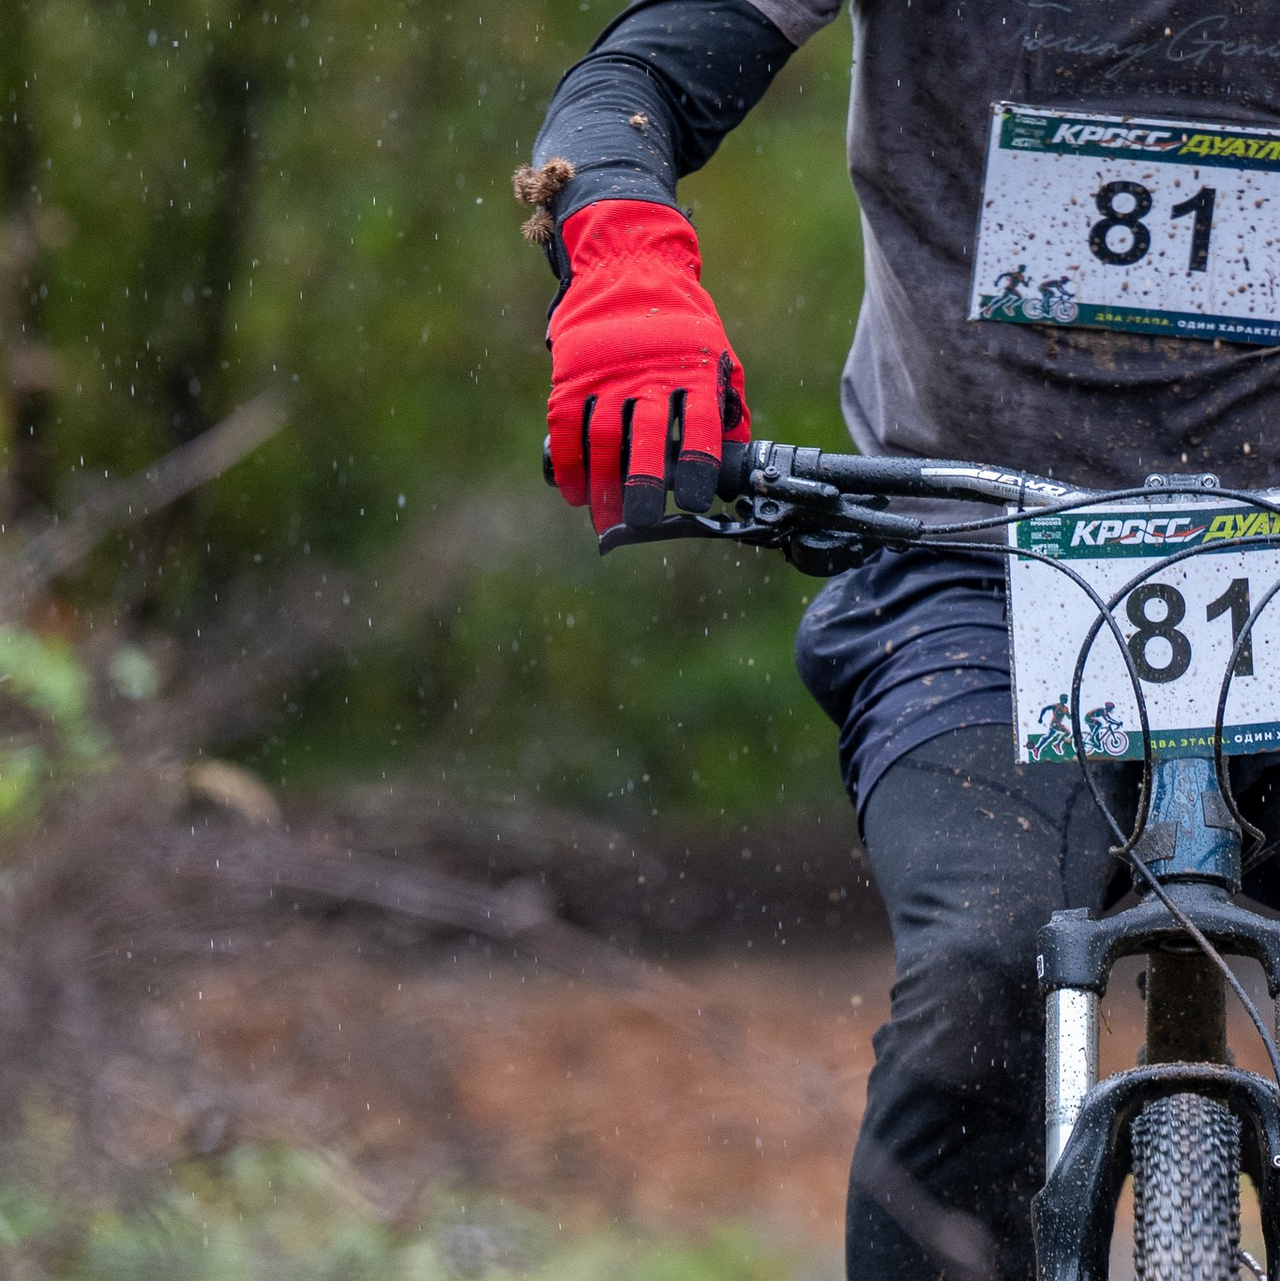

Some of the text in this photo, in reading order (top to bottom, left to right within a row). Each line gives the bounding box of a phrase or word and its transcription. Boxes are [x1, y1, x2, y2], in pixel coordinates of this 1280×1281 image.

[1052, 123, 1181, 151] КРОСС
[1088, 180, 1217, 272] 81
[1177, 320, 1216, 330] ОДИН
[1070, 517, 1207, 547] КРОСС
[1125, 577, 1254, 684] 81
[1150, 739, 1176, 749] ДВА
[1234, 731, 1273, 743] ОДИН
